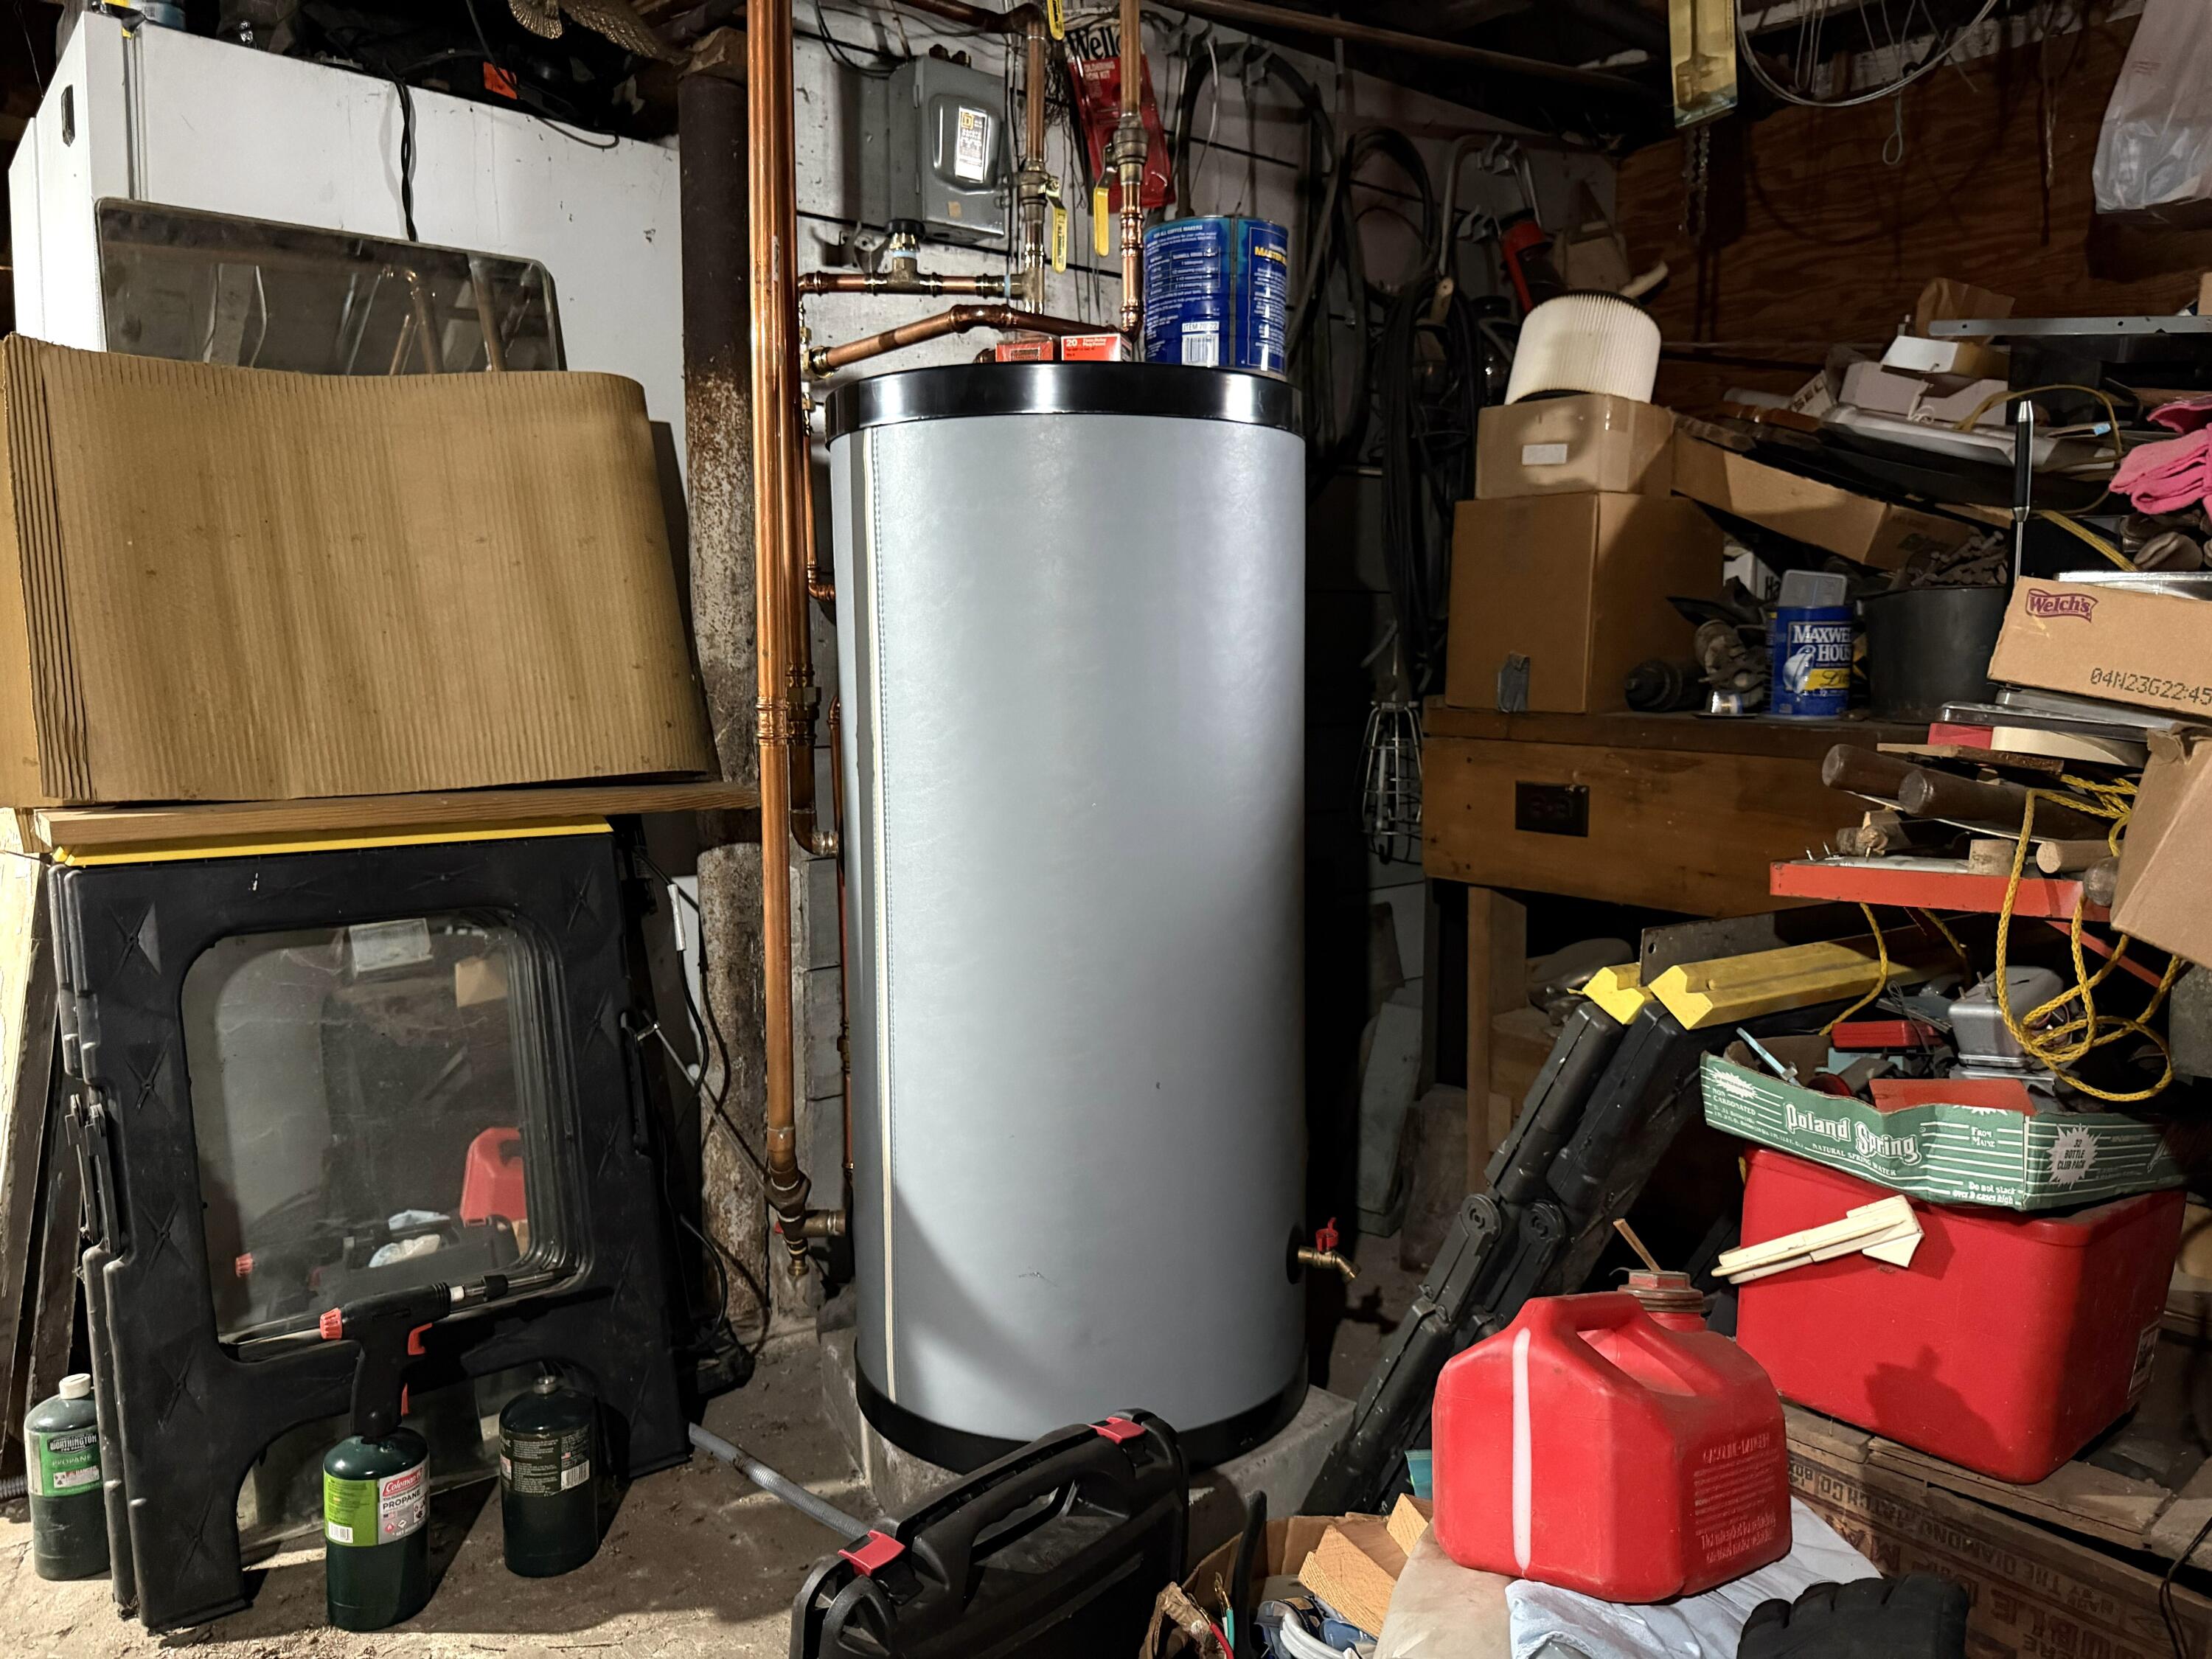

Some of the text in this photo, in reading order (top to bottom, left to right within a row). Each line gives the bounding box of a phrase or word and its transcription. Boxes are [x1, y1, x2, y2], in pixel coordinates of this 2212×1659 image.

[1183, 323, 1198, 331] ITEM
[1066, 338, 1078, 347] 20
[2028, 595, 2092, 614] Welch's
[1784, 1102, 1851, 1142] Poland
[1855, 1121, 1920, 1164] Spring
[2073, 1139, 2082, 1147] 32
[1812, 1143, 1896, 1176] NATURAL SPRING WATER
[2065, 1149, 2085, 1159] BOTTLE
[2057, 1160, 2086, 1169] CLUB PACK
[49, 1434, 97, 1451] WORTHINGTON
[52, 1454, 92, 1467] PROPANE
[386, 1475, 417, 1492] Coleman
[383, 1489, 421, 1510] PROPANE
[1918, 1520, 2017, 1576] DIAMOND
